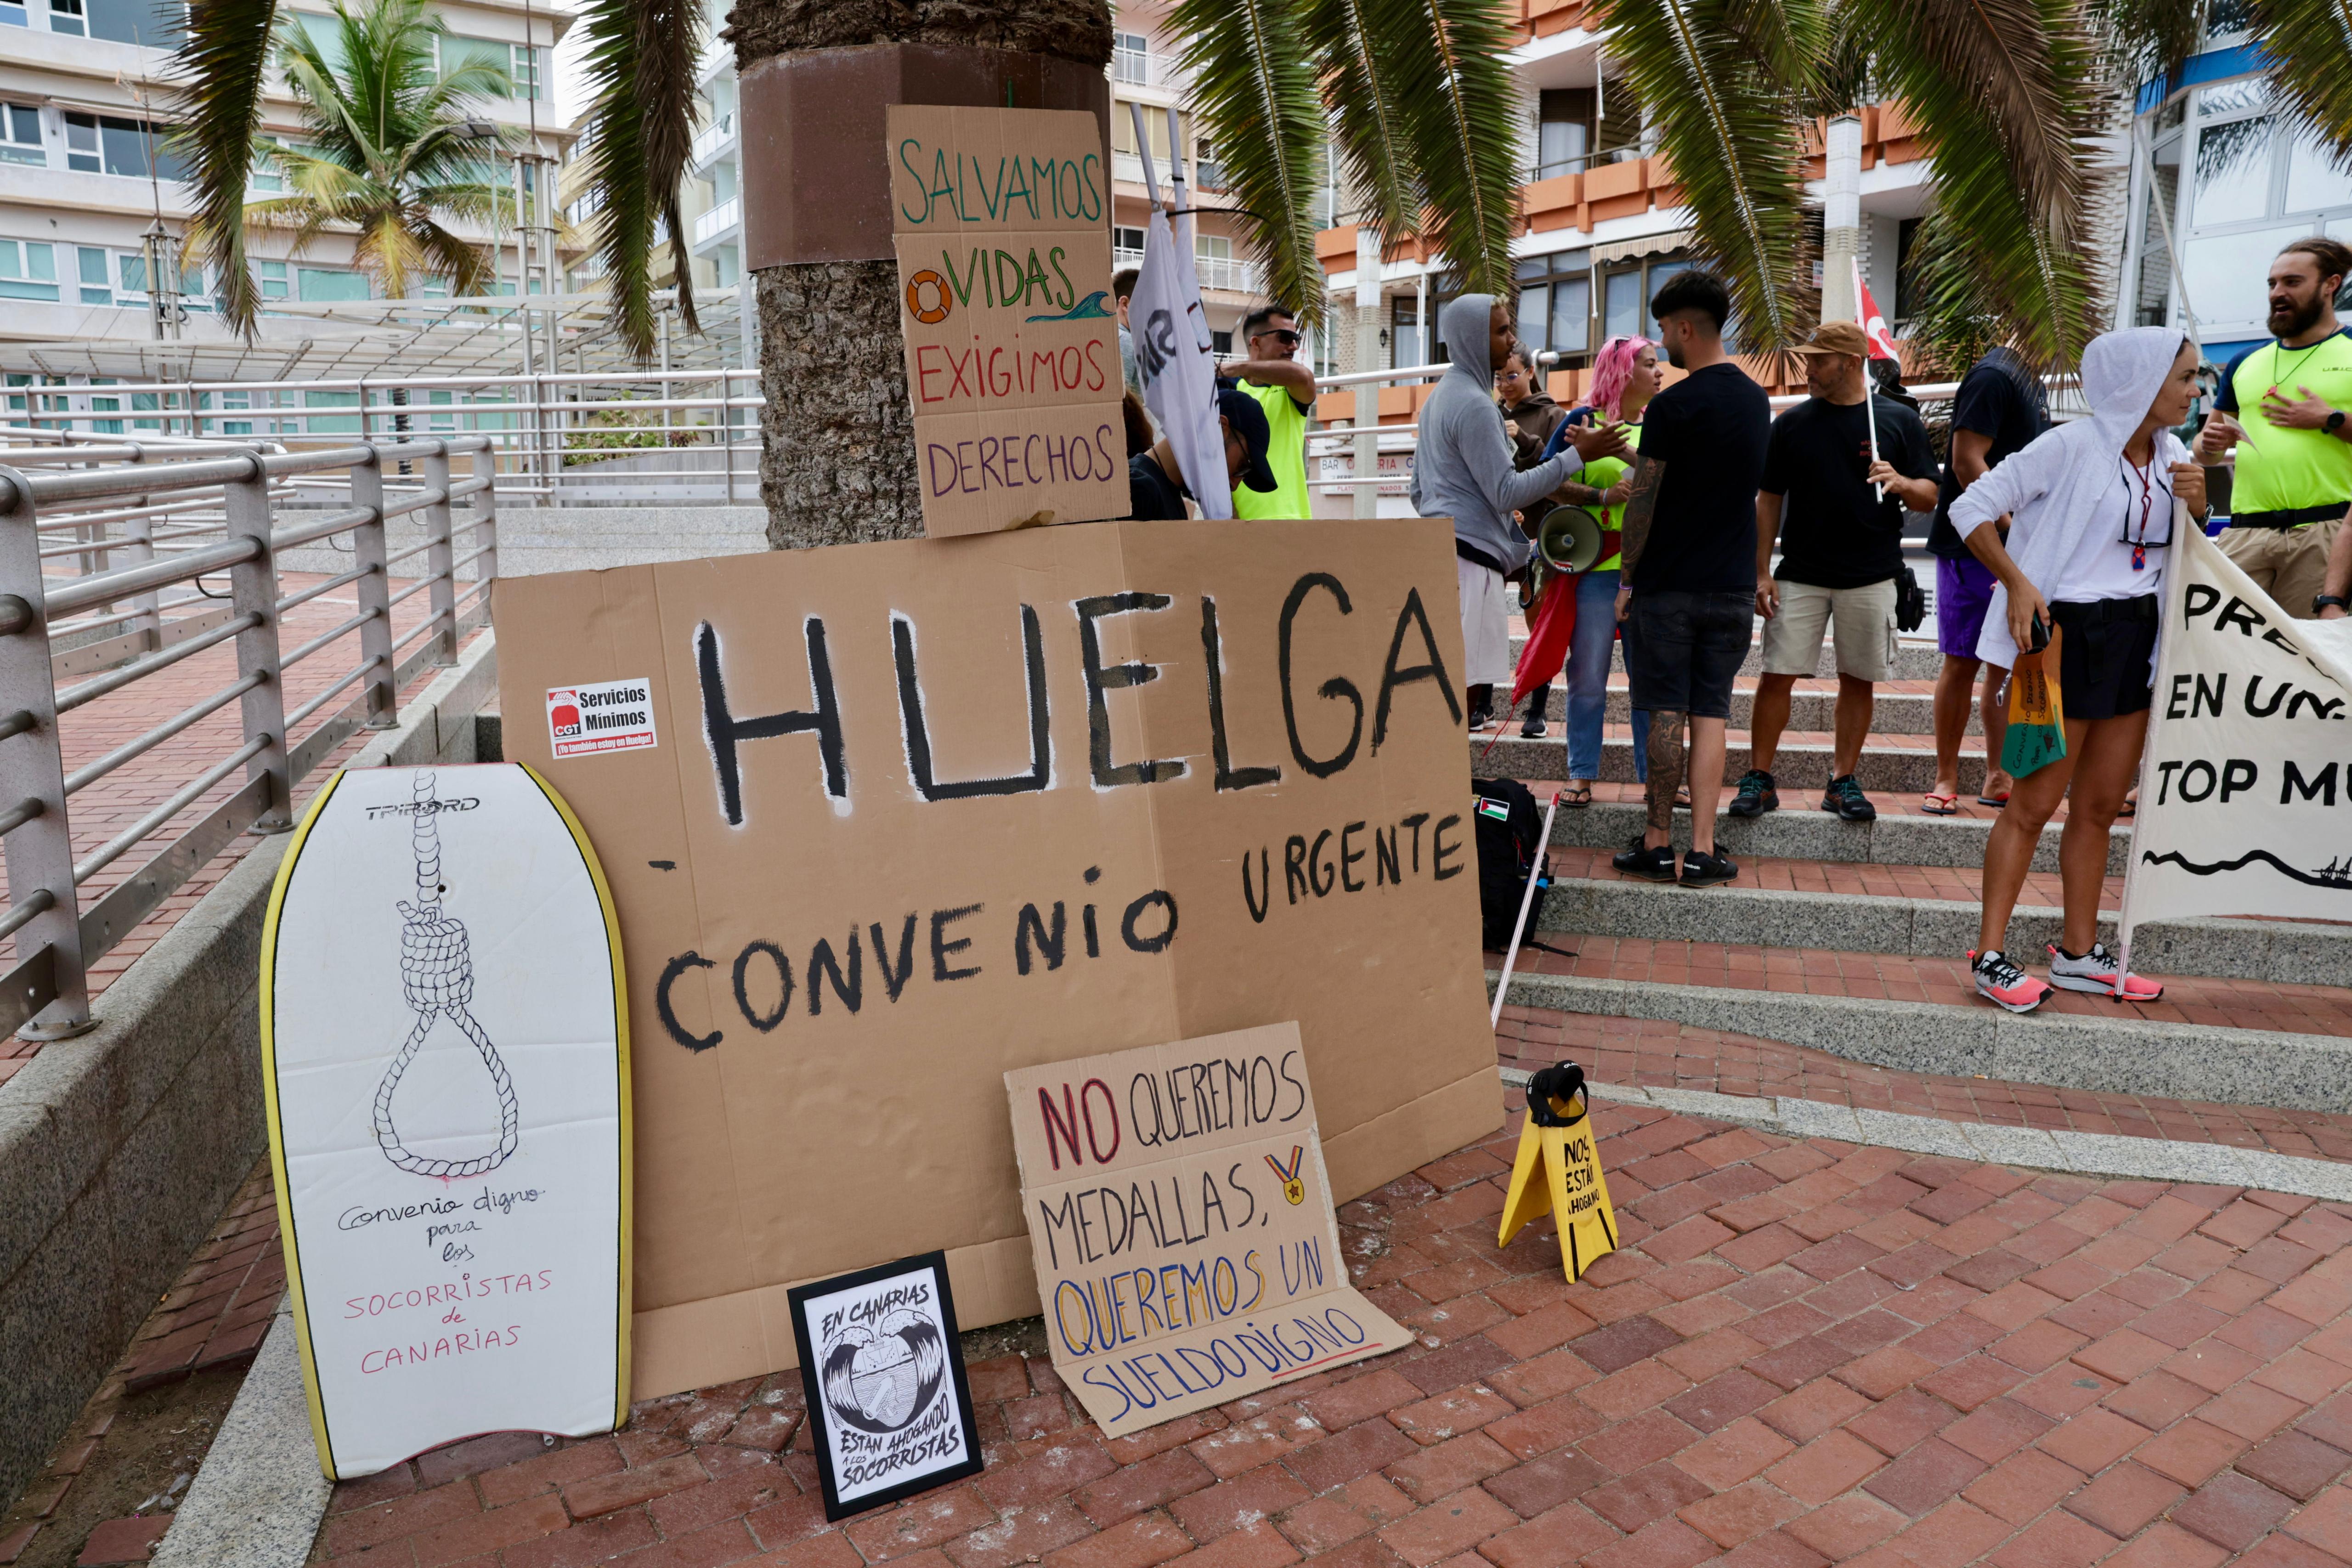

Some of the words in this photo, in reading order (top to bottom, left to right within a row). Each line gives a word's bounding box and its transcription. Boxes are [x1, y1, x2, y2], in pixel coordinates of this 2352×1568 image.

[899, 138, 1101, 224] SALVAMOS
[942, 247, 1074, 311] VIDAS
[927, 424, 1114, 498] DERECHOS
[1323, 460, 1338, 470] BAR
[579, 688, 646, 708] Servicios
[585, 712, 646, 730] Mínimos
[692, 572, 1463, 828] HUELGA
[2166, 673, 2228, 720] EN
[555, 724, 579, 736] CGT
[569, 740, 597, 752] también
[598, 739, 616, 749] estoy
[626, 734, 651, 746] Huelga!
[2013, 711, 2031, 770] CONVENIO
[2158, 759, 2258, 805] TOP
[1242, 813, 1464, 923] URGENTE
[1037, 1077, 1121, 1171] NO
[1130, 1050, 1305, 1148] QUEREMOS
[1564, 1134, 1590, 1167] NOS
[338, 1197, 464, 1230] Convenio
[473, 1186, 546, 1214] digno
[1039, 1163, 1268, 1270] MEDALLAS,
[426, 1220, 482, 1248] para
[442, 1242, 475, 1262] los
[344, 1270, 552, 1319] SOCORRISTAS
[442, 1306, 466, 1324] de
[821, 1305, 845, 1343] EN
[849, 1281, 929, 1327] CANARIAS
[1055, 1249, 1267, 1357] QUEREMOS
[1279, 1235, 1323, 1296] UN
[361, 1325, 521, 1374] CANARIAS
[887, 1392, 950, 1453] AHOGANDO
[838, 1424, 960, 1493] SOCORRISTAS
[850, 1455, 867, 1465] LOS
